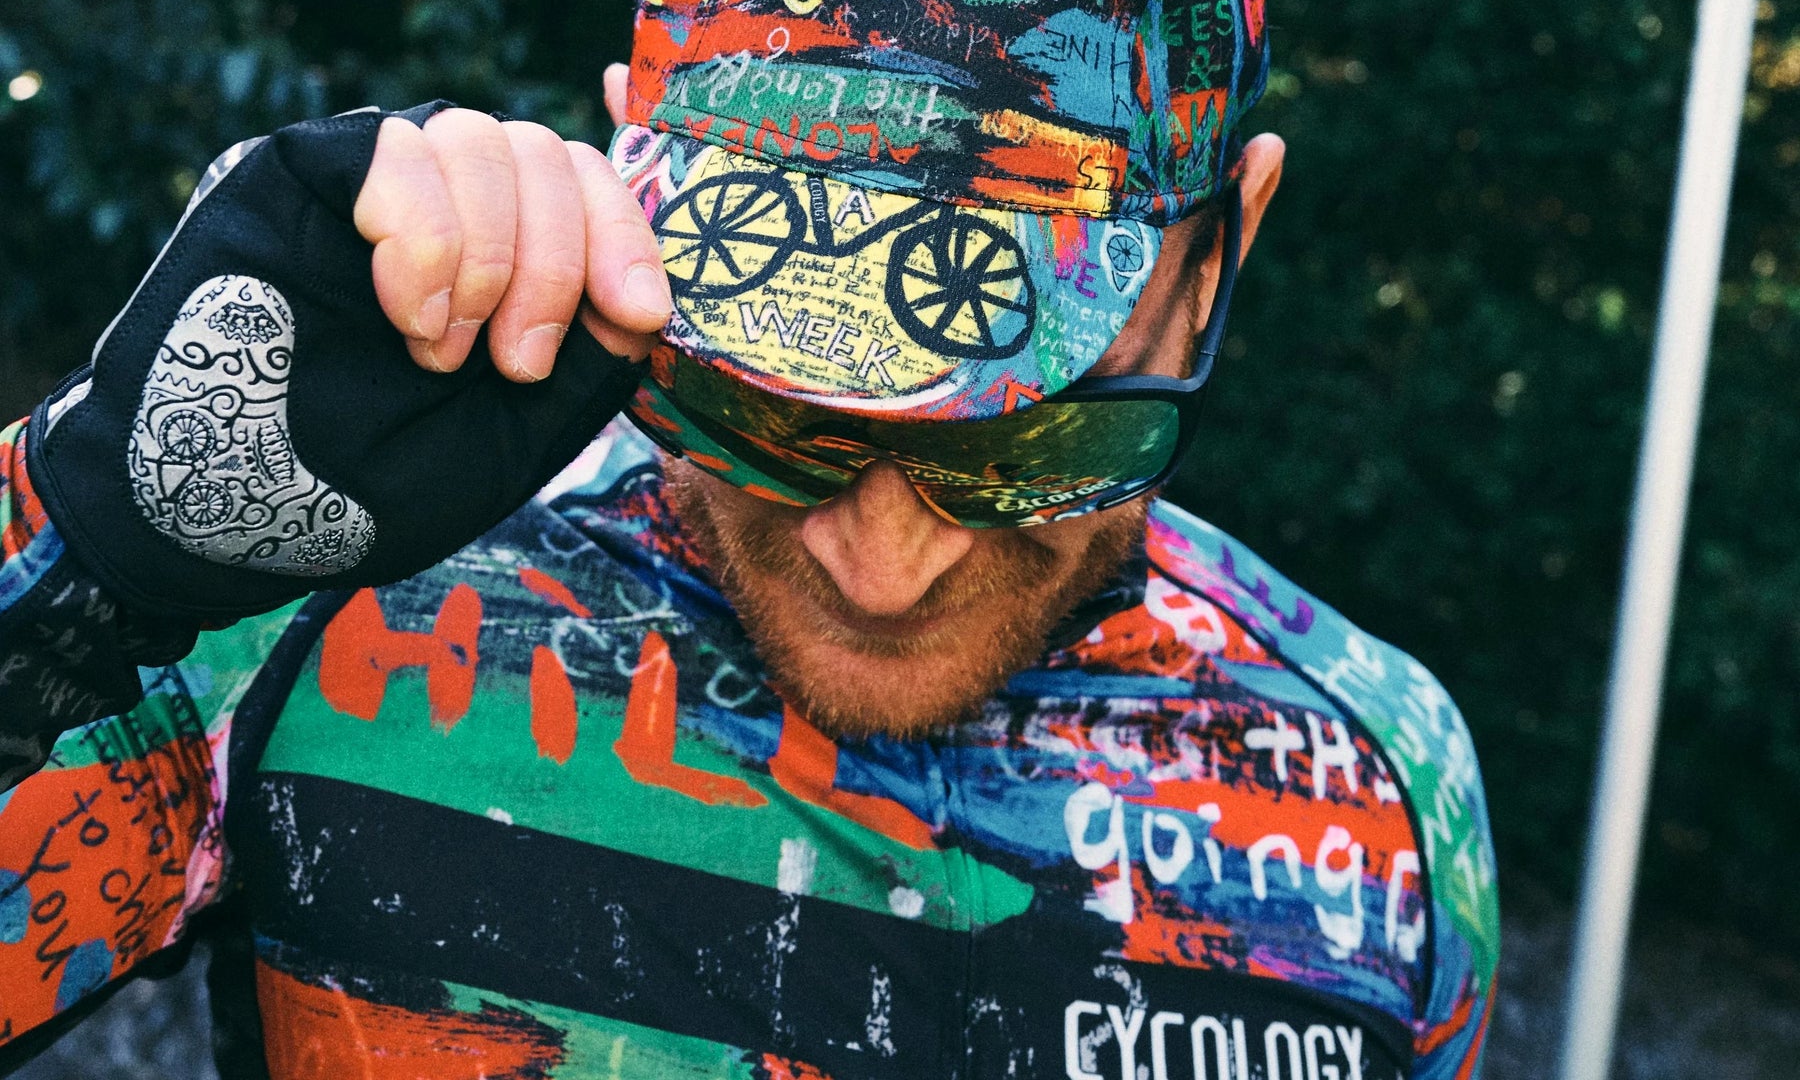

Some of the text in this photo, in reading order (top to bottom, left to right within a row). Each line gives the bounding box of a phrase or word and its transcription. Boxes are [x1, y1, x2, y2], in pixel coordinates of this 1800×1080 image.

[809, 176, 827, 223] YCOLOGY
[832, 185, 876, 227] A
[738, 299, 902, 388] WEEK
[318, 575, 940, 852] HILL
[1064, 999, 1364, 1080] CYCOLOGY
